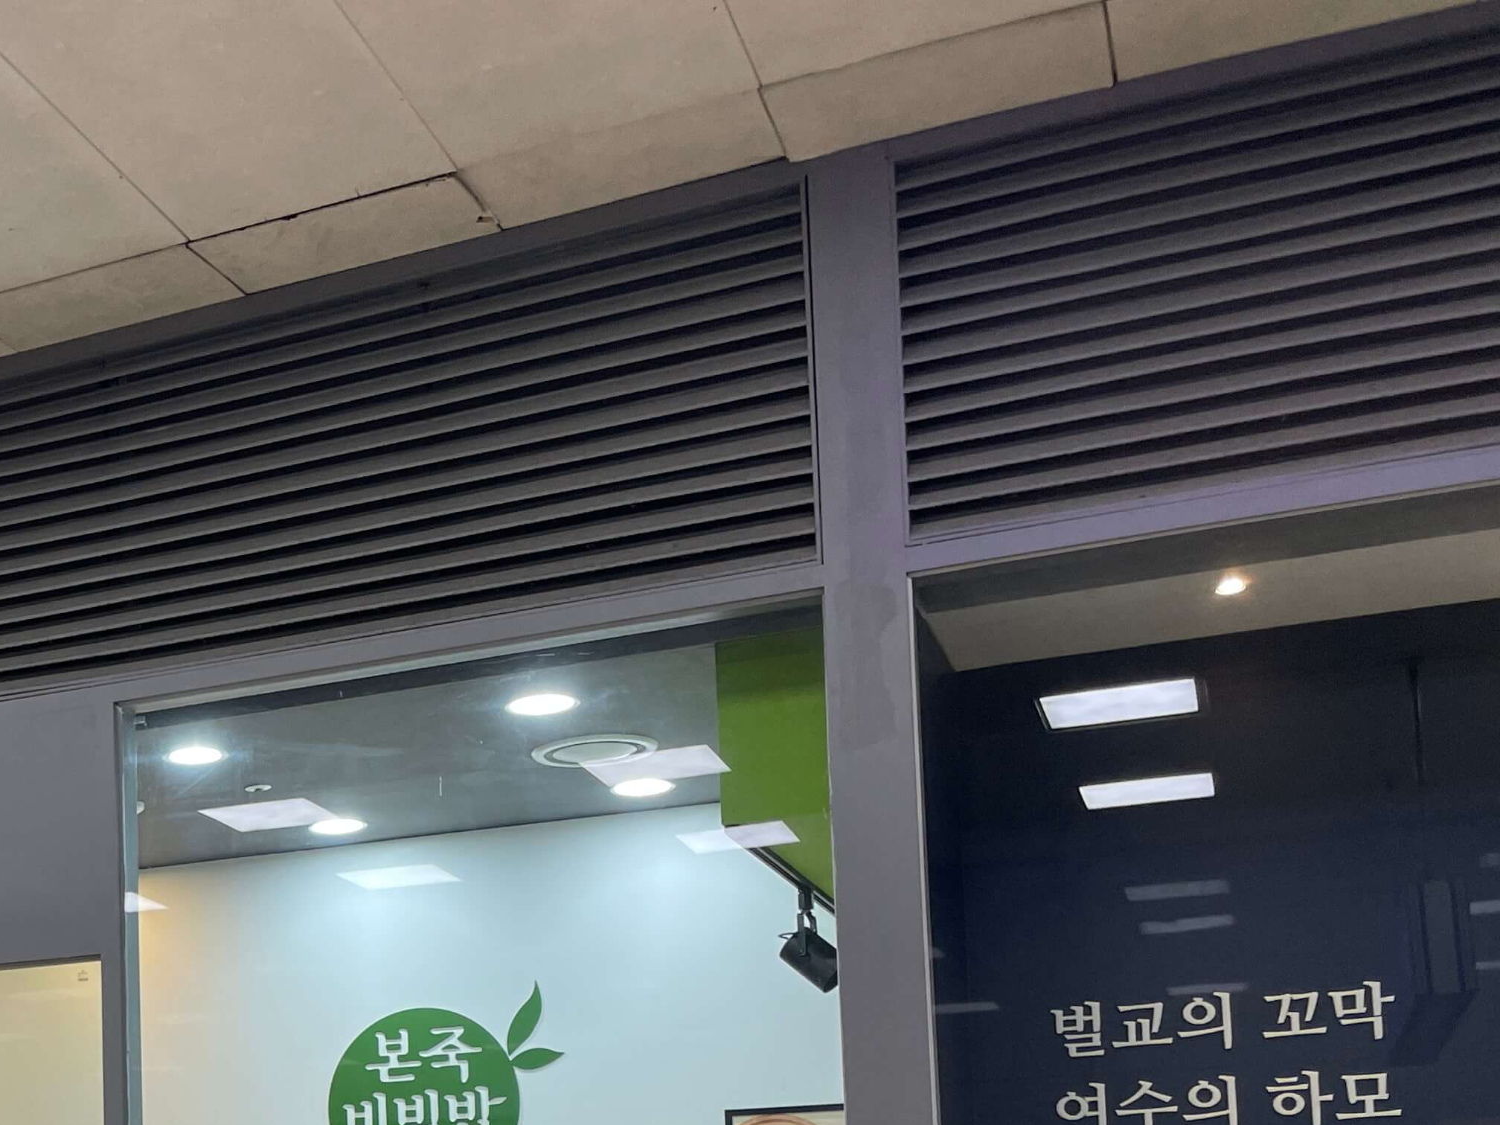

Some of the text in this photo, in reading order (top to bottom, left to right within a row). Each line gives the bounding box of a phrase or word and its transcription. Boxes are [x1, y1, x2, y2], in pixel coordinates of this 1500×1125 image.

[1050, 980, 1395, 1058] 벌교의 꼬막
[364, 1026, 482, 1083] 본죽
